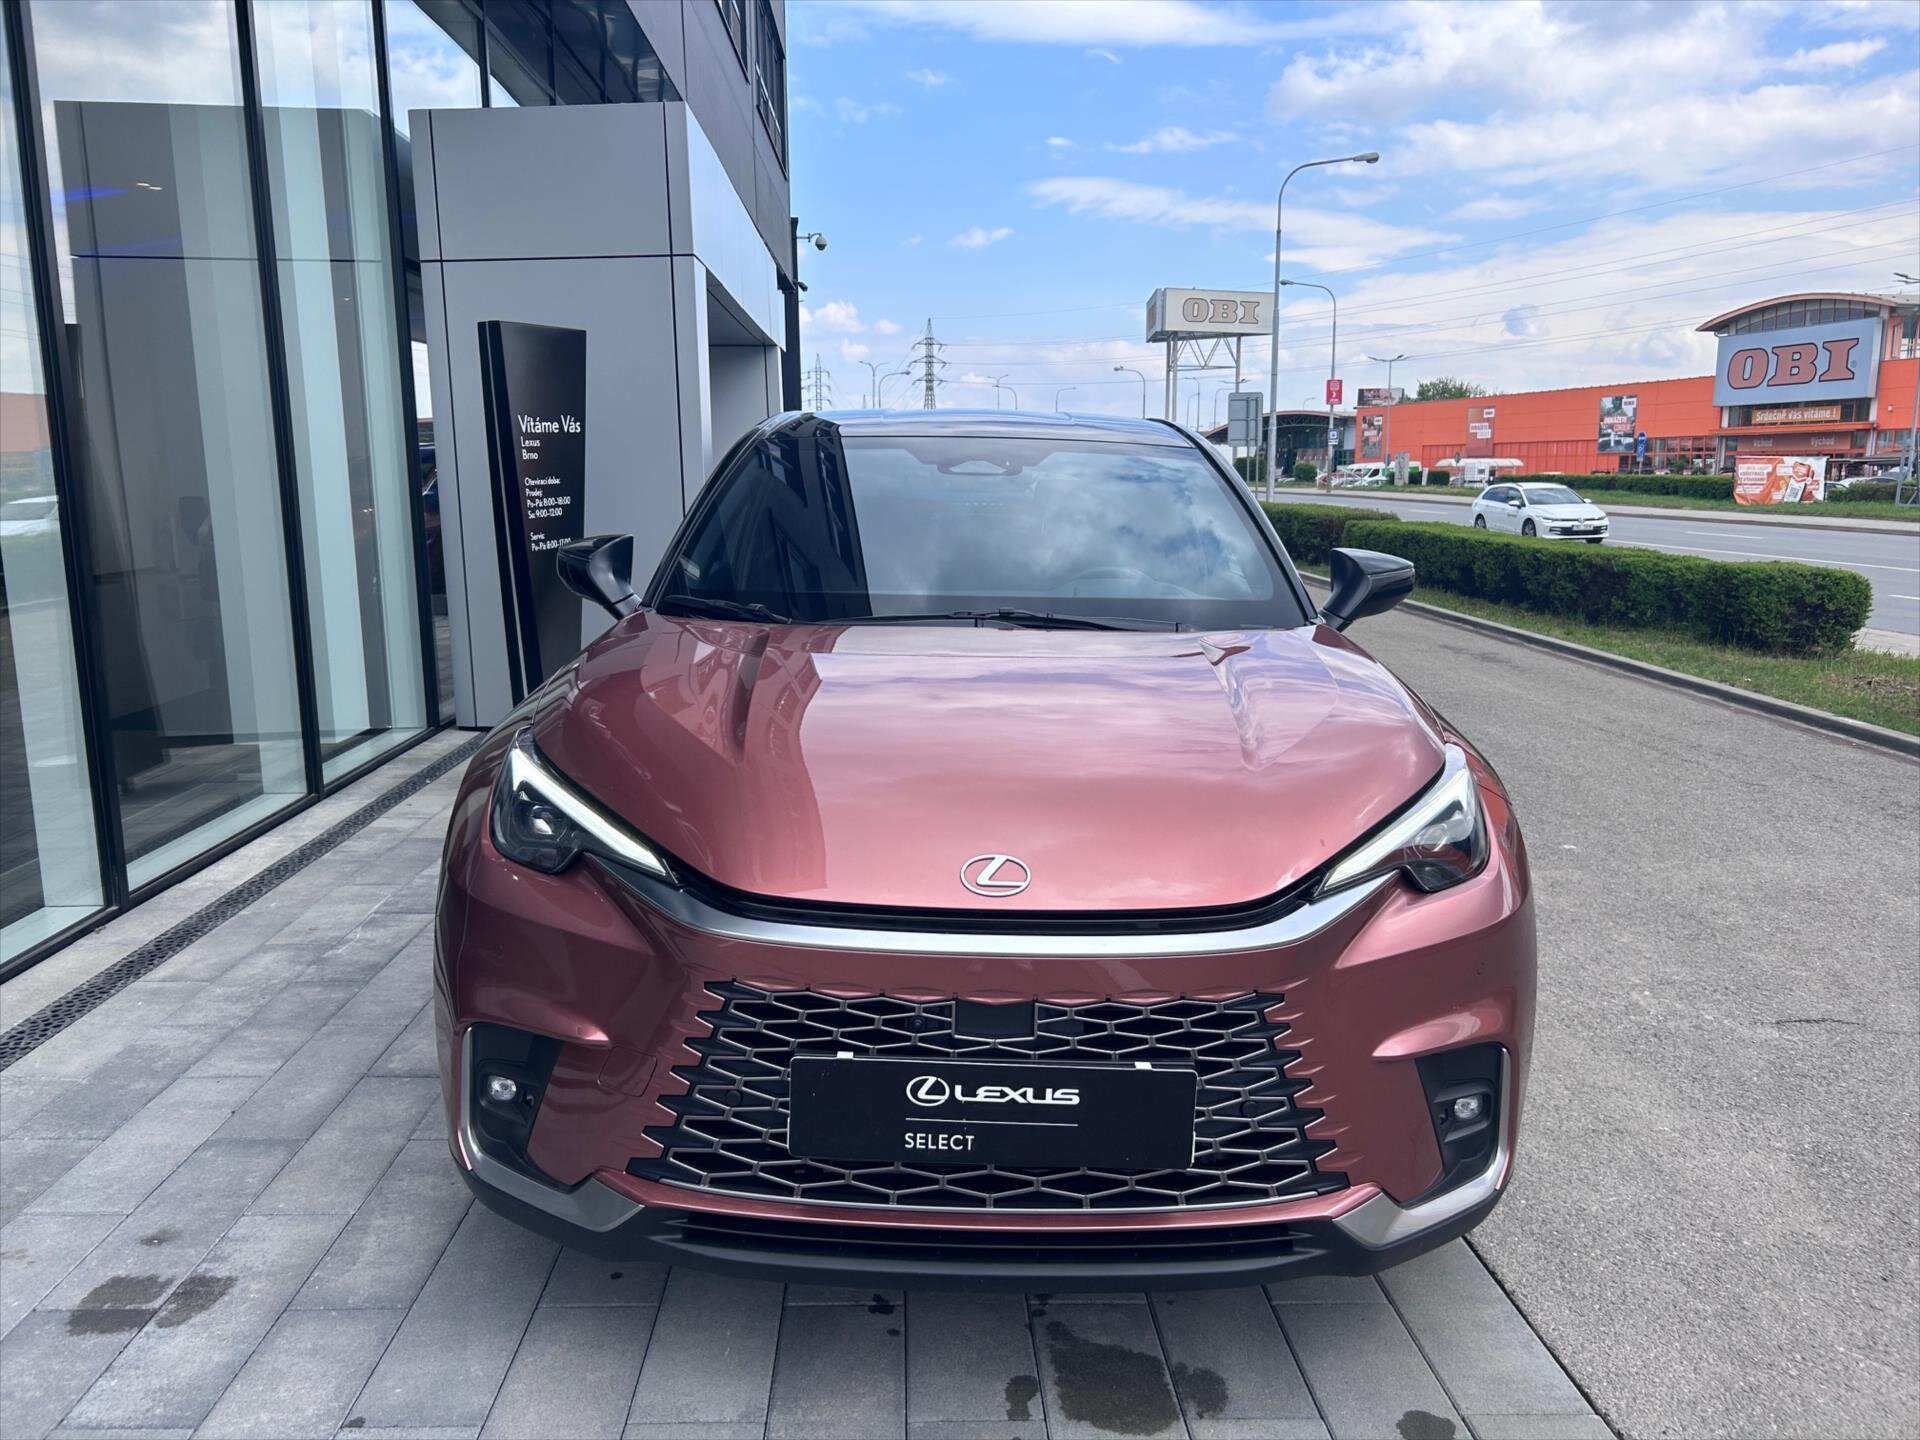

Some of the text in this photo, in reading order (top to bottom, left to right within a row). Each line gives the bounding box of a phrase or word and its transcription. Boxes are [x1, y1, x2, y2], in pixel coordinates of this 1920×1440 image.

[1182, 297, 1260, 324] OBI
[1727, 337, 1860, 390] OBI
[517, 414, 581, 433] Vítáme Vás
[520, 436, 541, 447] Lexus
[521, 449, 539, 460] Brno
[954, 1084, 1080, 1105] LEXUS
[904, 1132, 975, 1152] SELECT
